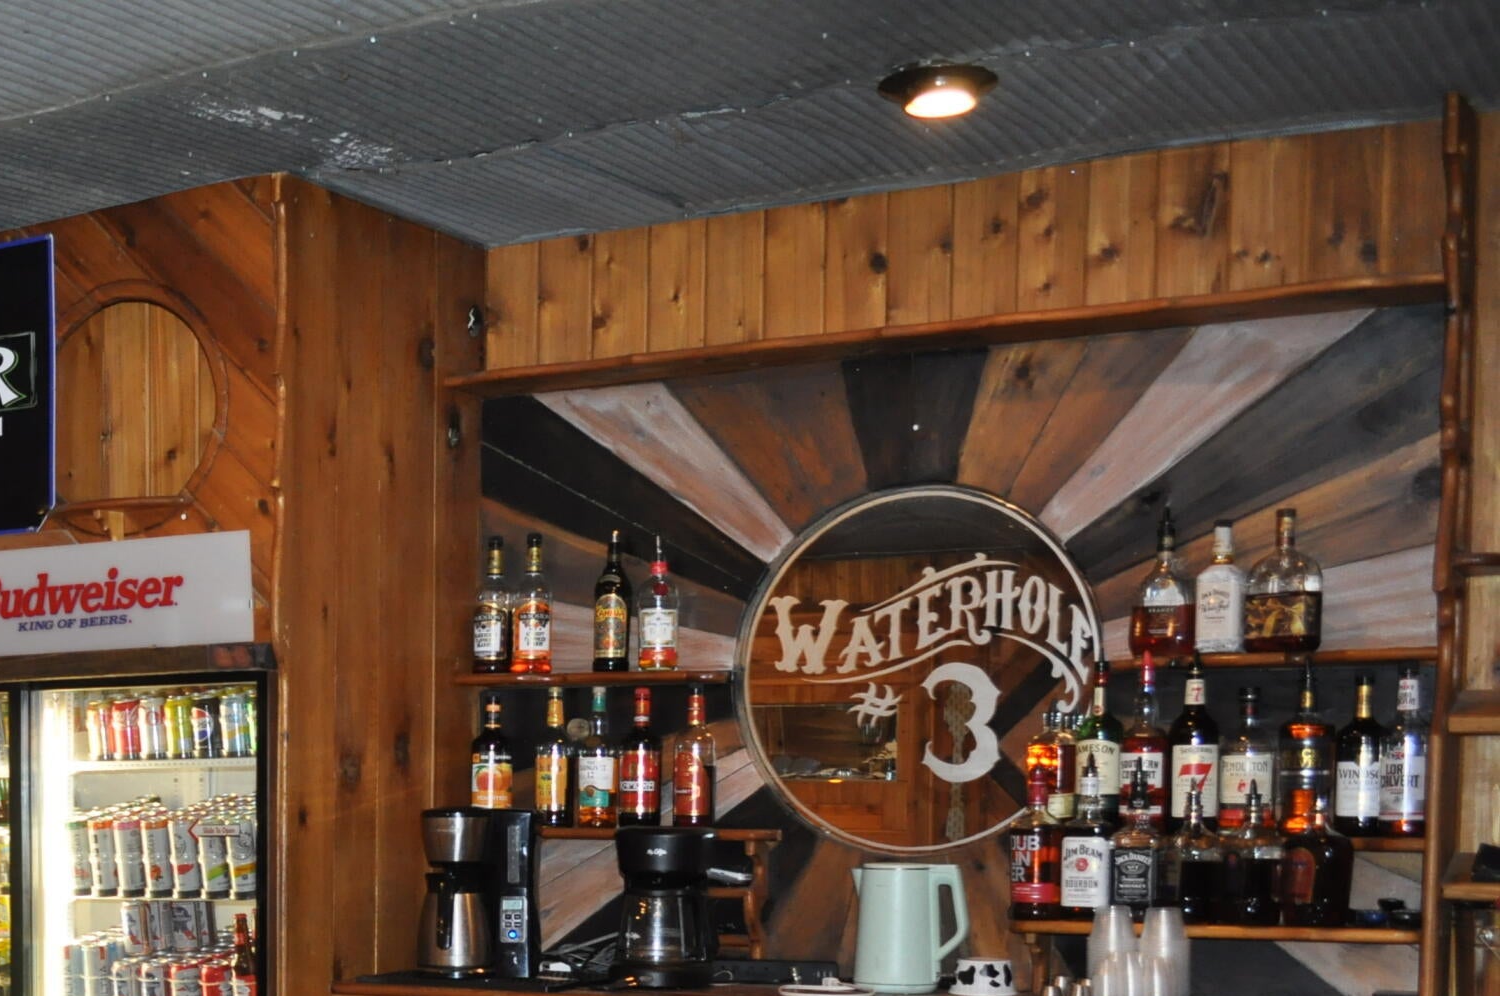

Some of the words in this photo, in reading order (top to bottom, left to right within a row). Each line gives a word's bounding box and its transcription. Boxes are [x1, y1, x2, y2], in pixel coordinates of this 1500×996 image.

[18, 620, 53, 632] KING
[57, 618, 76, 630] OF
[769, 569, 1094, 686] WATERHOLE
[920, 662, 1001, 782] 3
[1077, 743, 1115, 755] AMESON
[1121, 759, 1159, 769] SOUTERN
[1222, 760, 1268, 772] PENDLTON
[1386, 763, 1406, 775] LOR
[1063, 847, 1079, 861] JIM
[1080, 843, 1103, 860] BEAM
